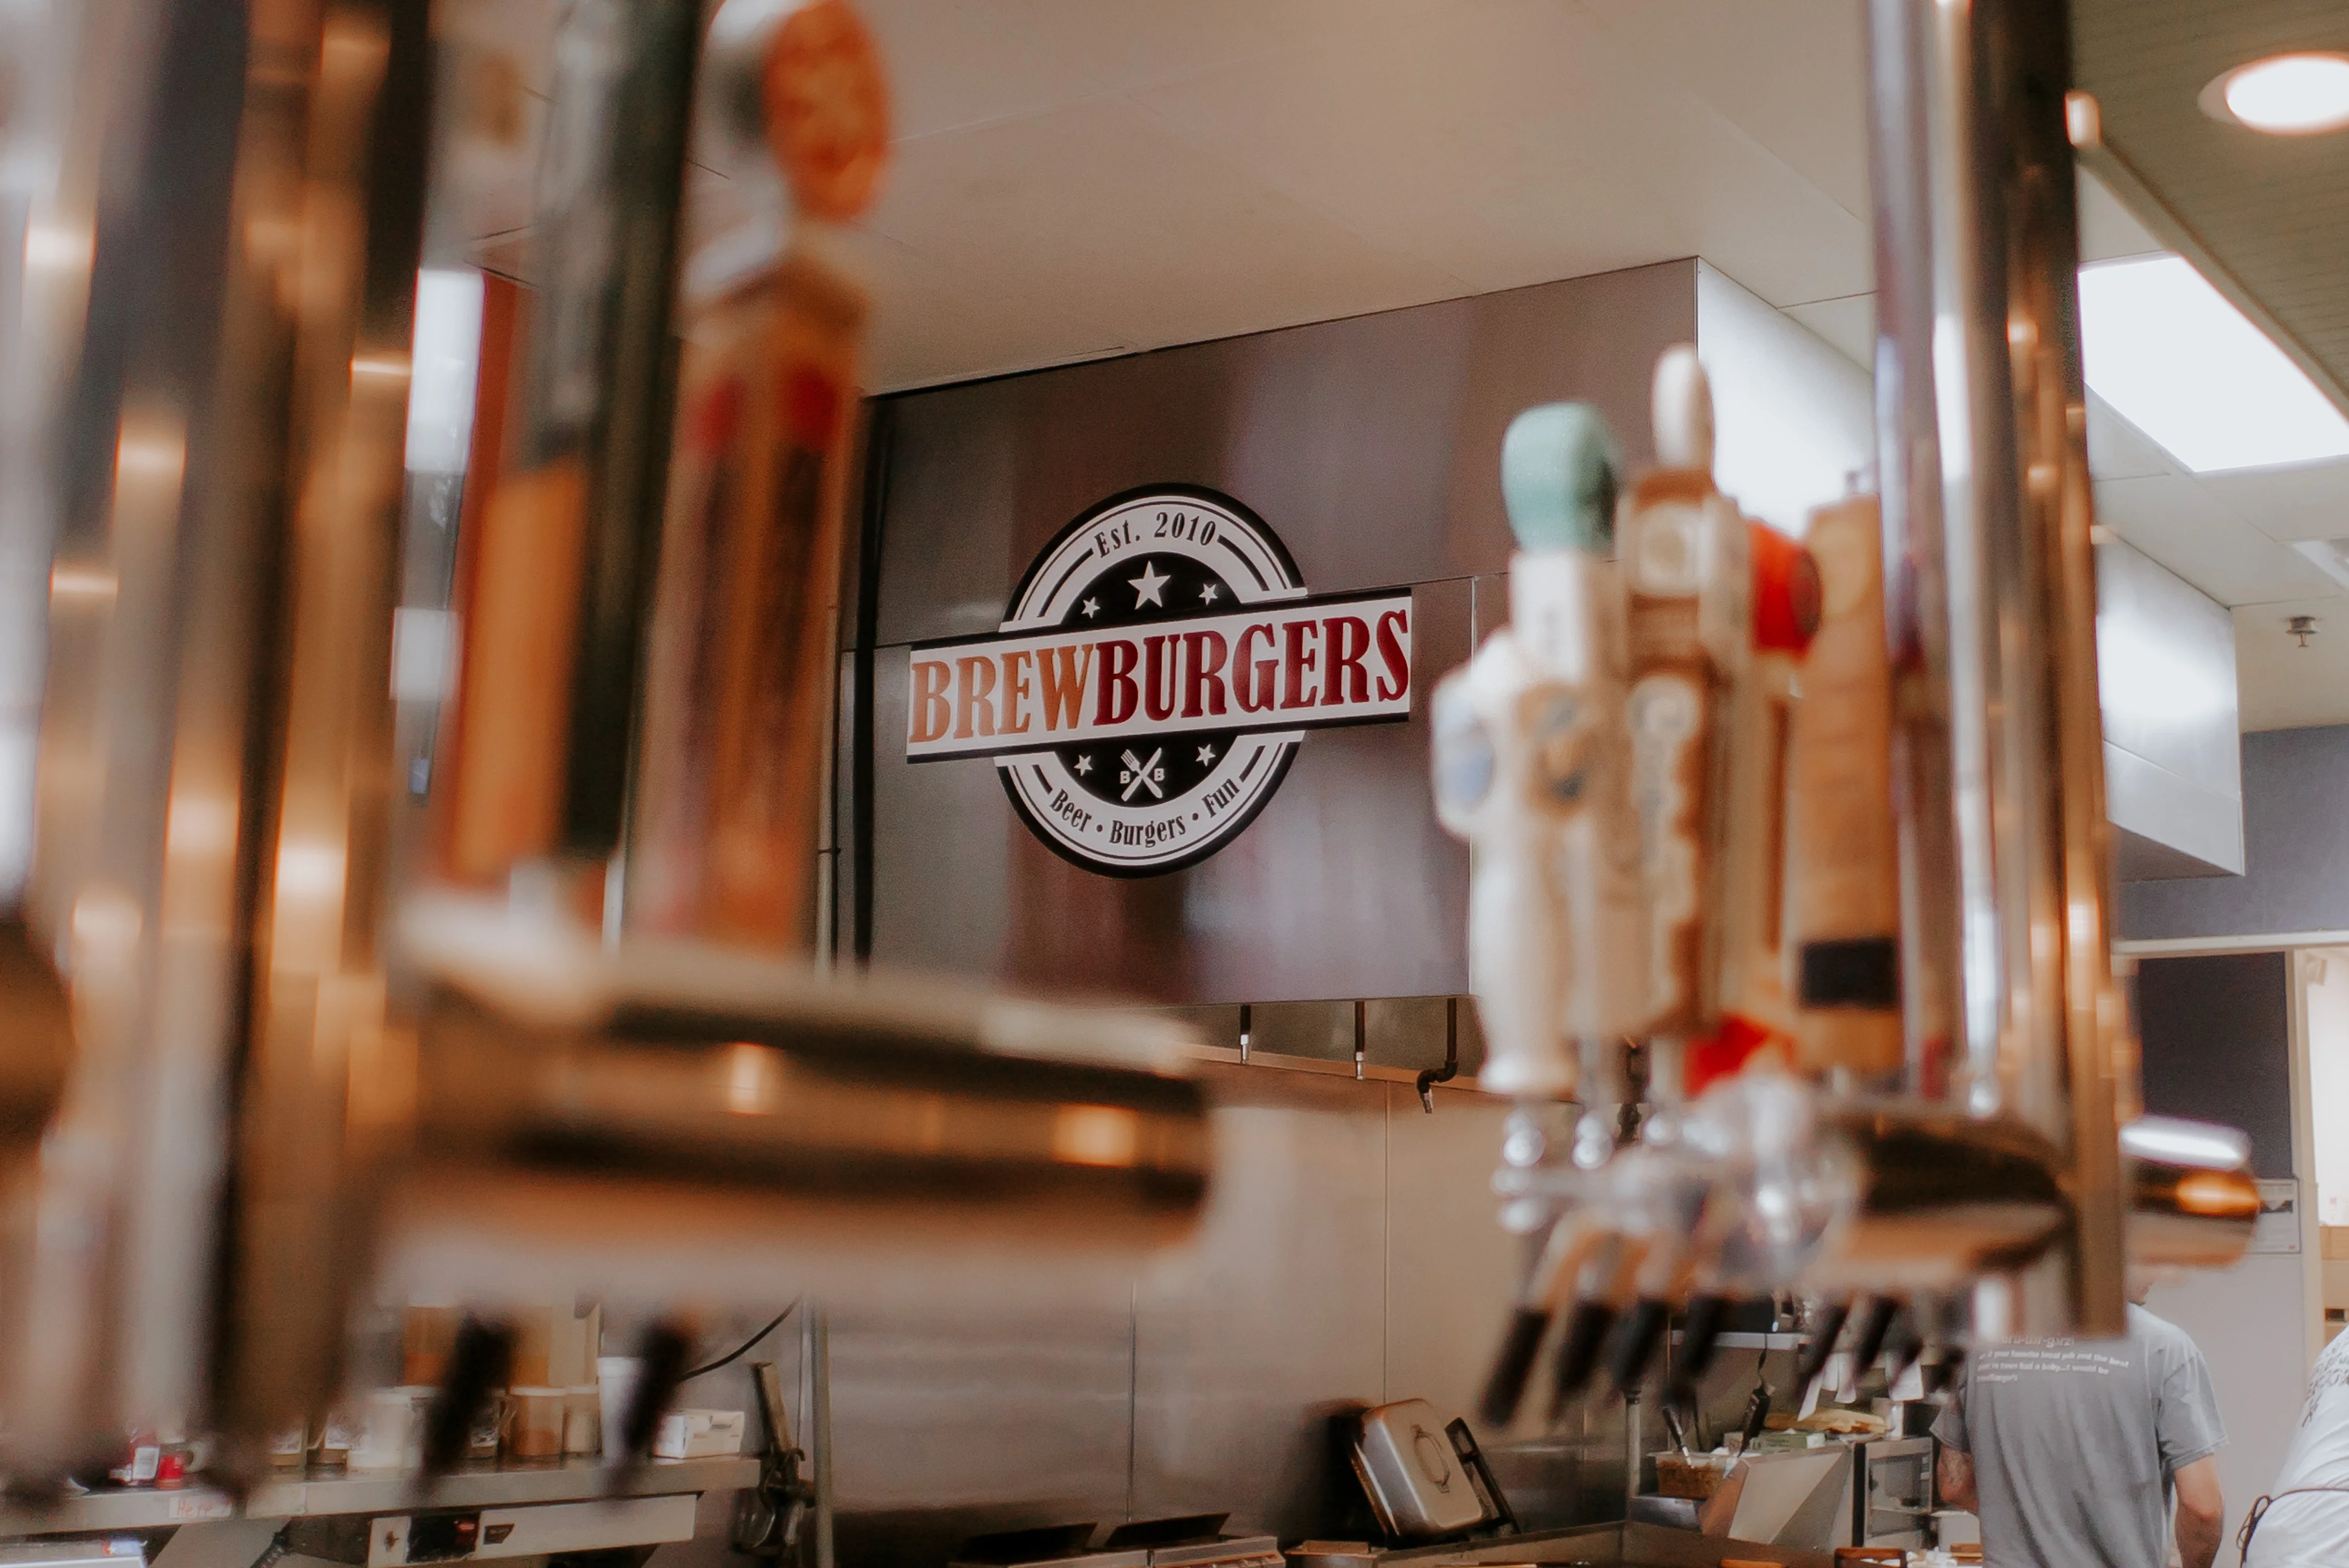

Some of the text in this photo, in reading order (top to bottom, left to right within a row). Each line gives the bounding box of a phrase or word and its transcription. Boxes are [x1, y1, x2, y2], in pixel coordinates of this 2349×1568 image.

[1094, 512, 1216, 558] Est. 2010
[908, 609, 1409, 744] BREWBURGERS
[1049, 778, 1240, 848] Beer Burgers Fun
